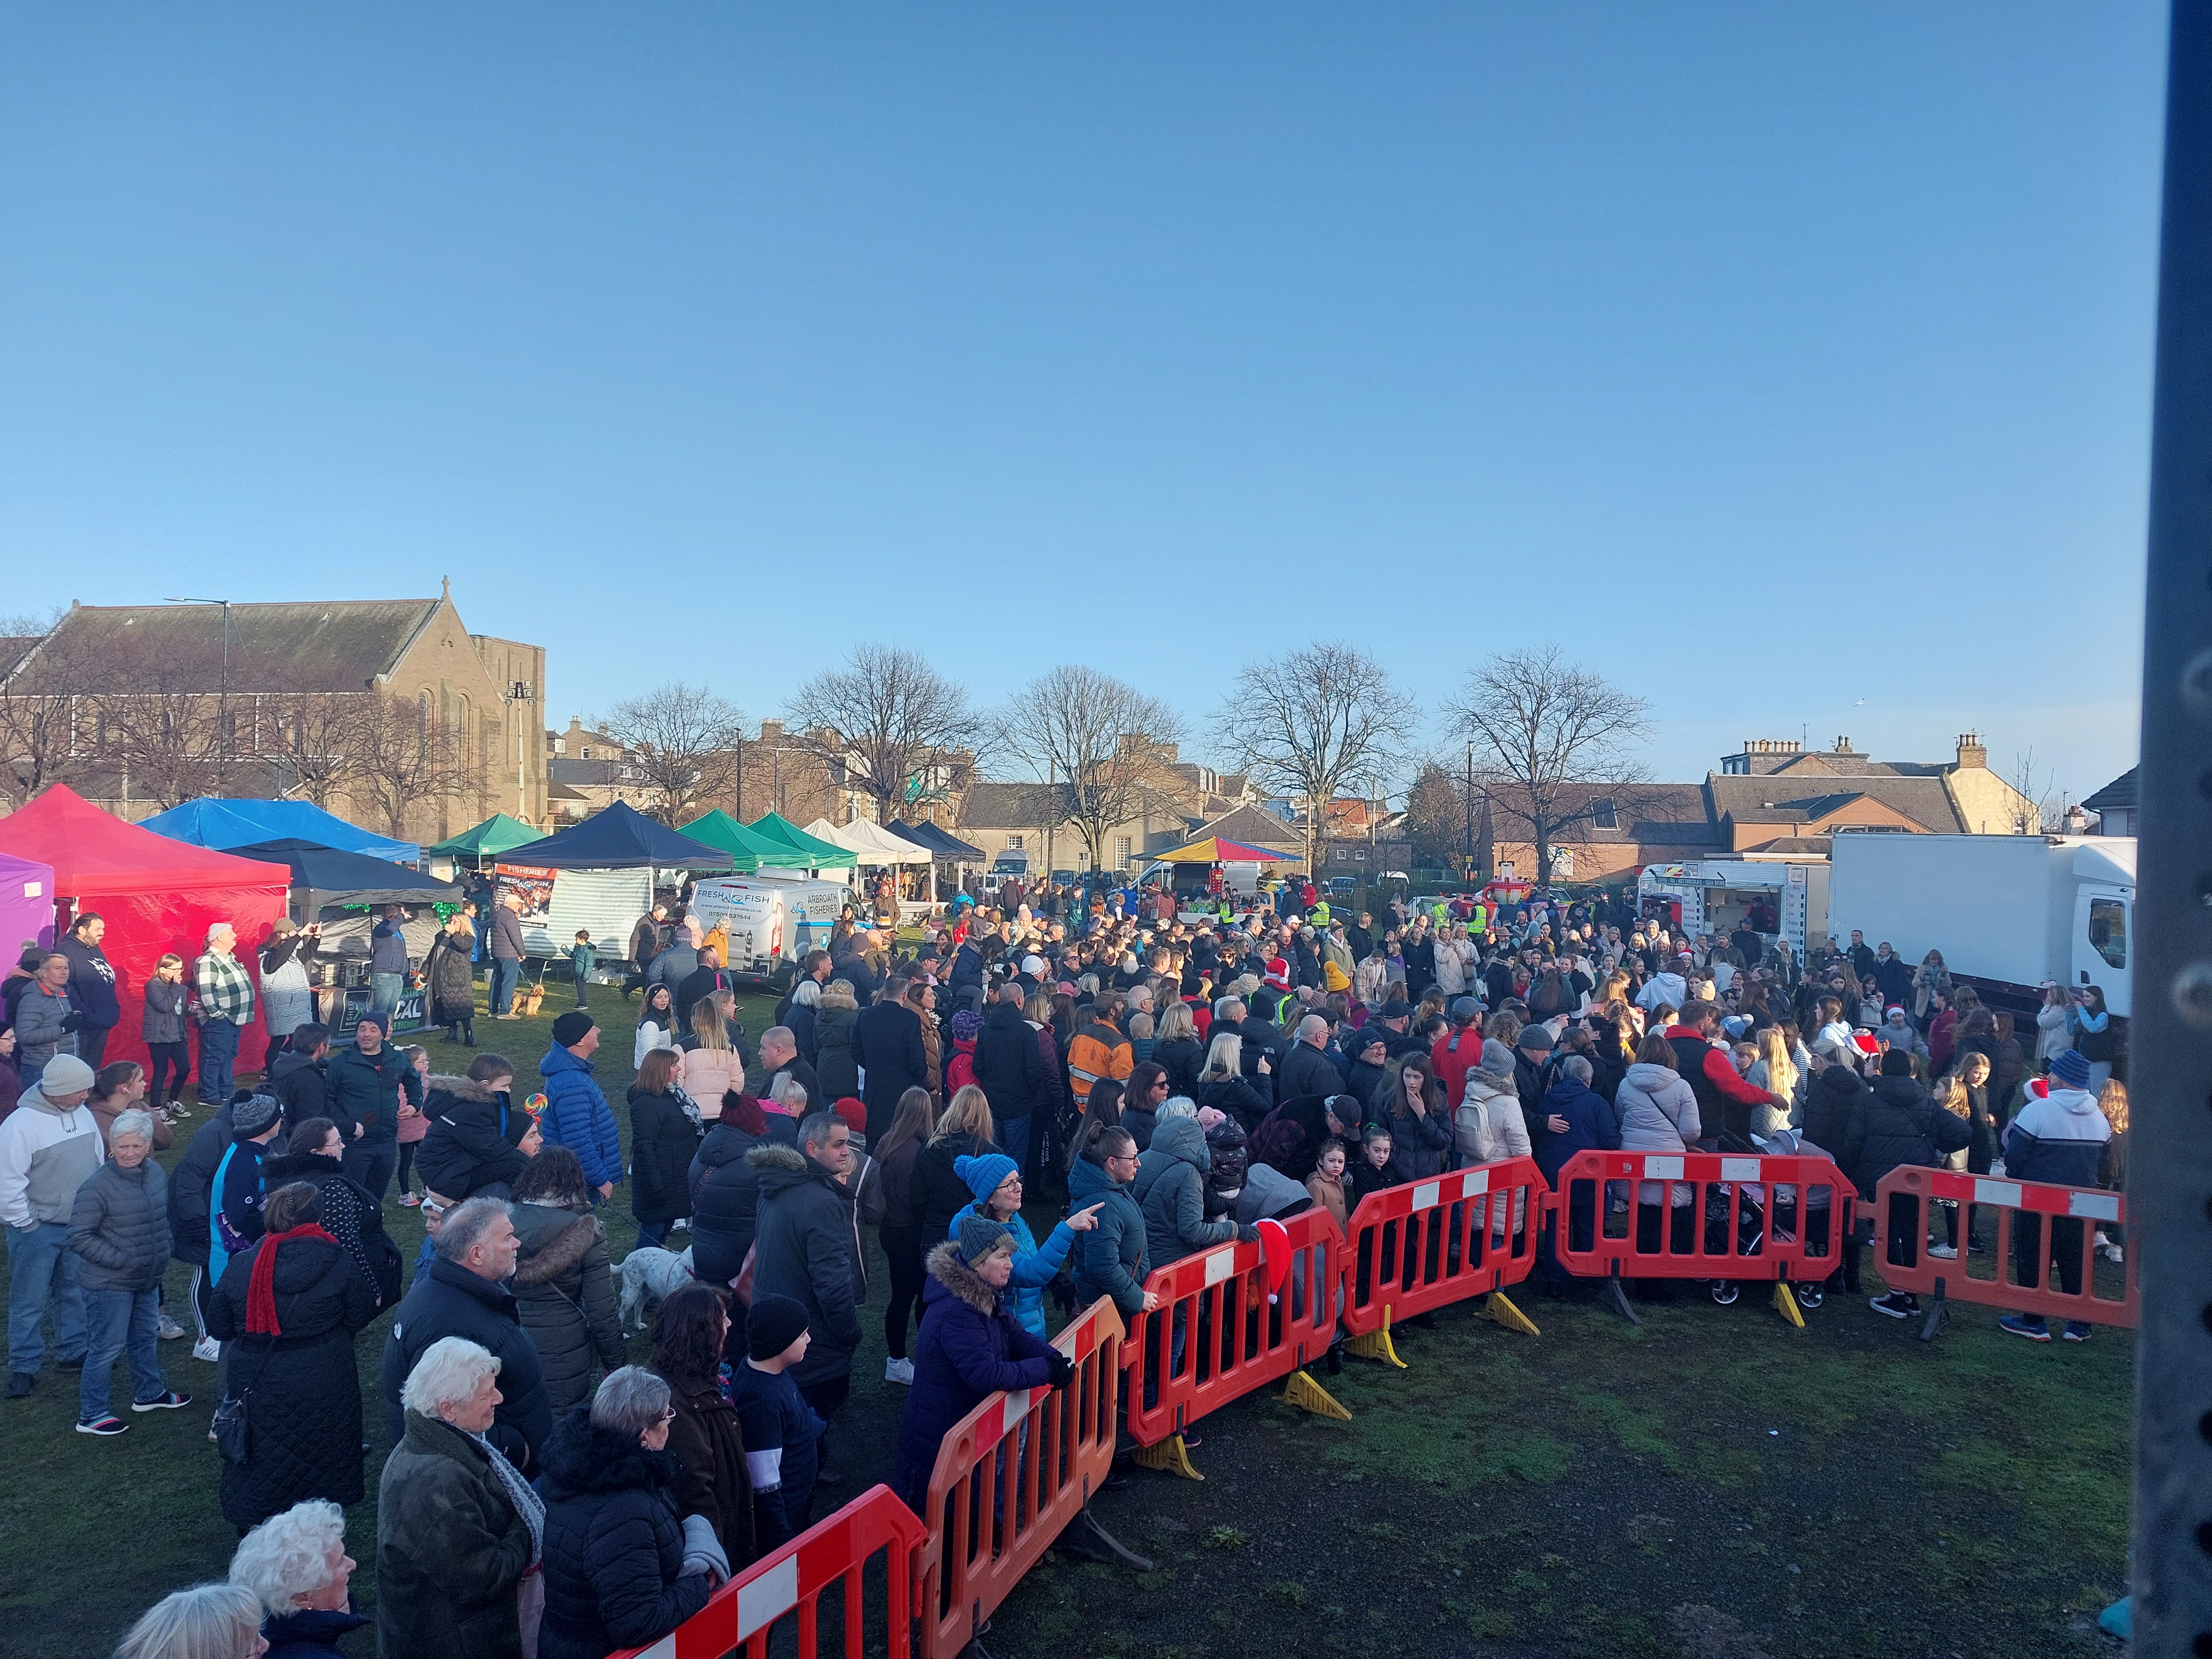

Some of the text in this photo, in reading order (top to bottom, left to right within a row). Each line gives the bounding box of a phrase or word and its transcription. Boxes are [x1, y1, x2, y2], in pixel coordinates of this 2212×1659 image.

[508, 866, 548, 876] FISHERIES
[499, 876, 520, 885] FRESH
[697, 890, 770, 904] FRESH FISH
[808, 893, 837, 904] ARBROATH
[810, 904, 838, 916] FISHERIES
[729, 912, 751, 920] 537644
[394, 998, 421, 1020] CAL
